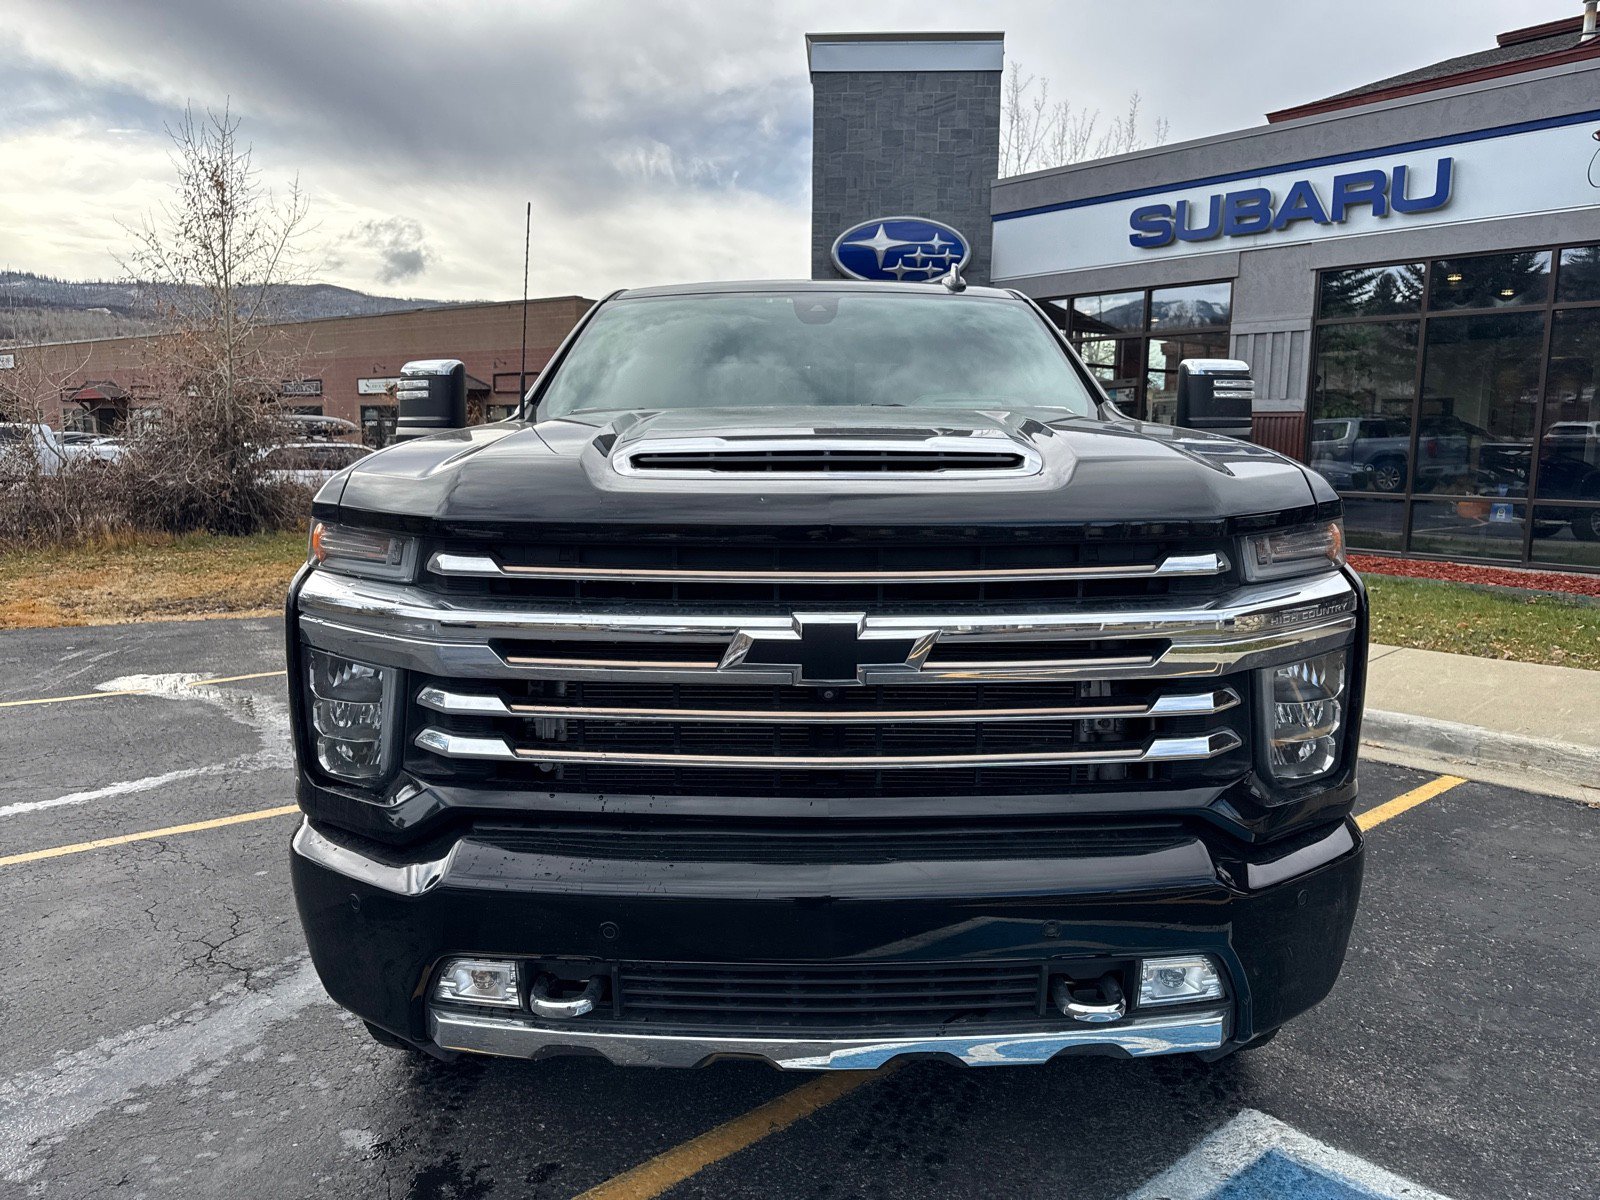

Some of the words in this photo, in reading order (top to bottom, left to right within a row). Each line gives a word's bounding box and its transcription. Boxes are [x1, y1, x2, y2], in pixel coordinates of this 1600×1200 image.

[1129, 157, 1454, 249] SUBARU
[1270, 613, 1299, 625] HIGH
[1302, 602, 1348, 620] COUNTRY
